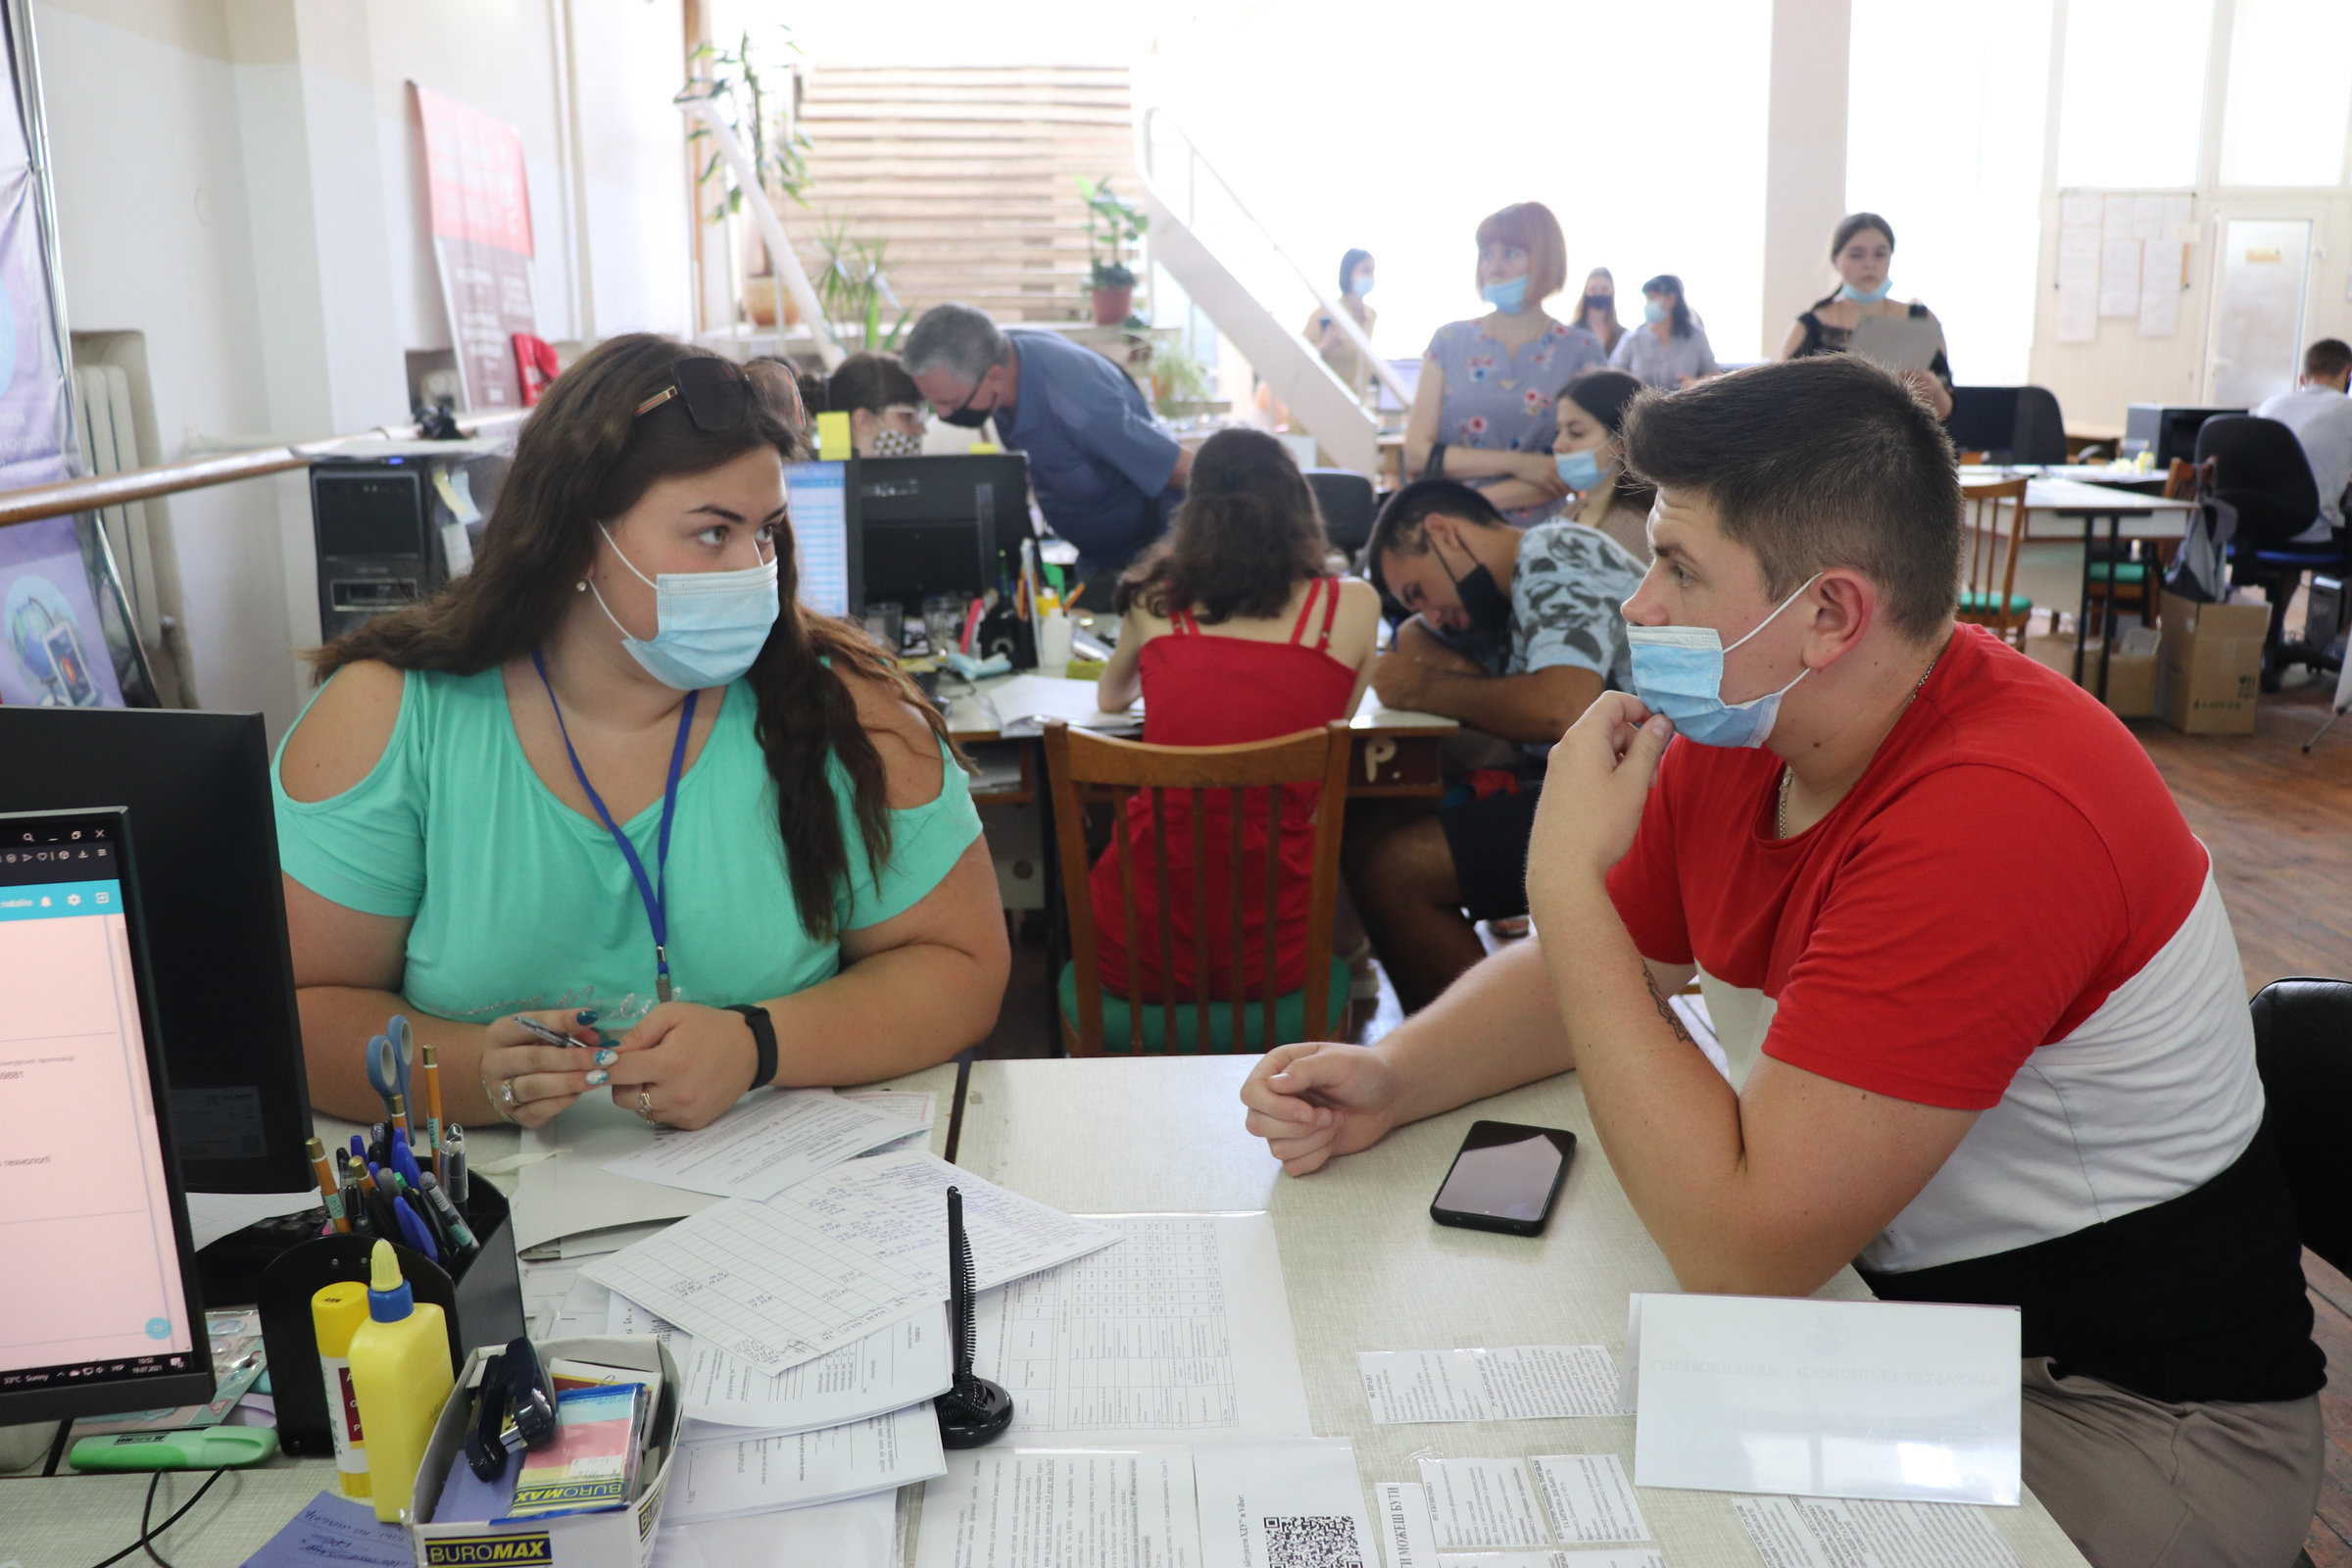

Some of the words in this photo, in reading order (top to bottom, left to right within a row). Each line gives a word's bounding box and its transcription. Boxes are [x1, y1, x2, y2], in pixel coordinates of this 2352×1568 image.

[25, 1373, 49, 1384] Sunny
[514, 1483, 622, 1503] BUROMAX
[1387, 1487, 1403, 1511] БУТИ
[1391, 1514, 1411, 1555] МОЖЕШ
[430, 1541, 545, 1565] BUROMAX
